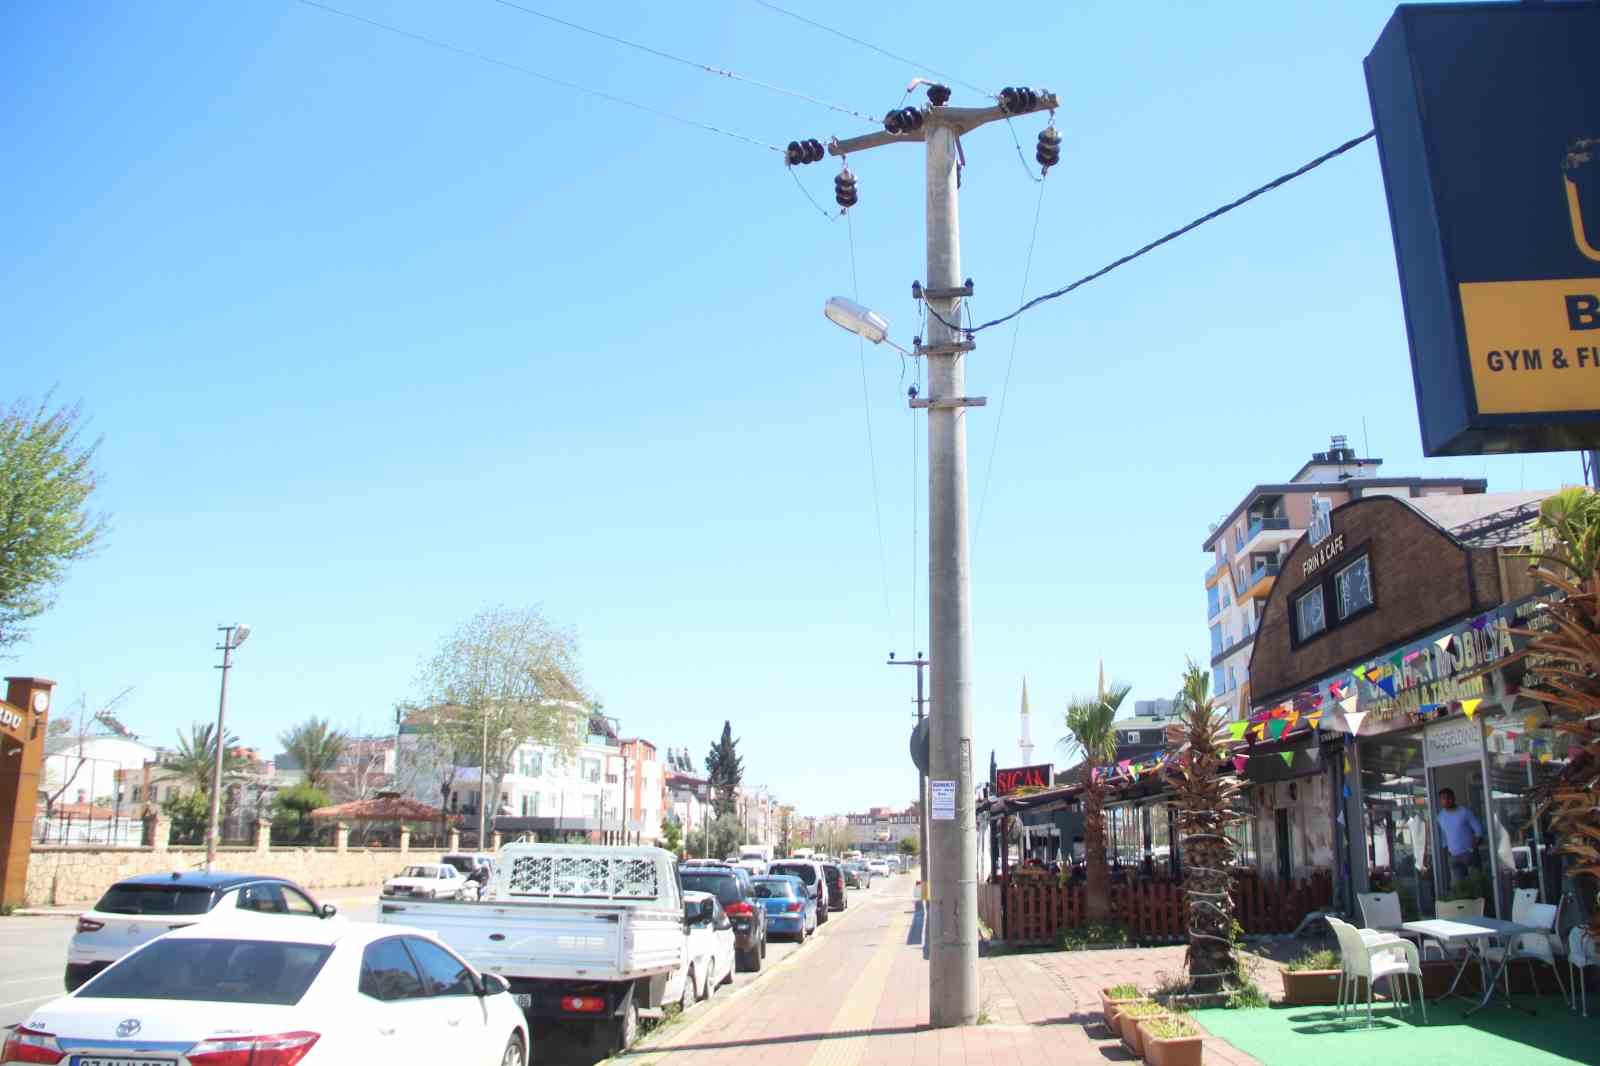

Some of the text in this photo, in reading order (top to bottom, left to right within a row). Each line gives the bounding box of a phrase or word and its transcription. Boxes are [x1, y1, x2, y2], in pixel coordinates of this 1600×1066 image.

[1487, 349, 1542, 372] GYM
[1552, 347, 1569, 369] &
[1325, 534, 1344, 560] CAFE
